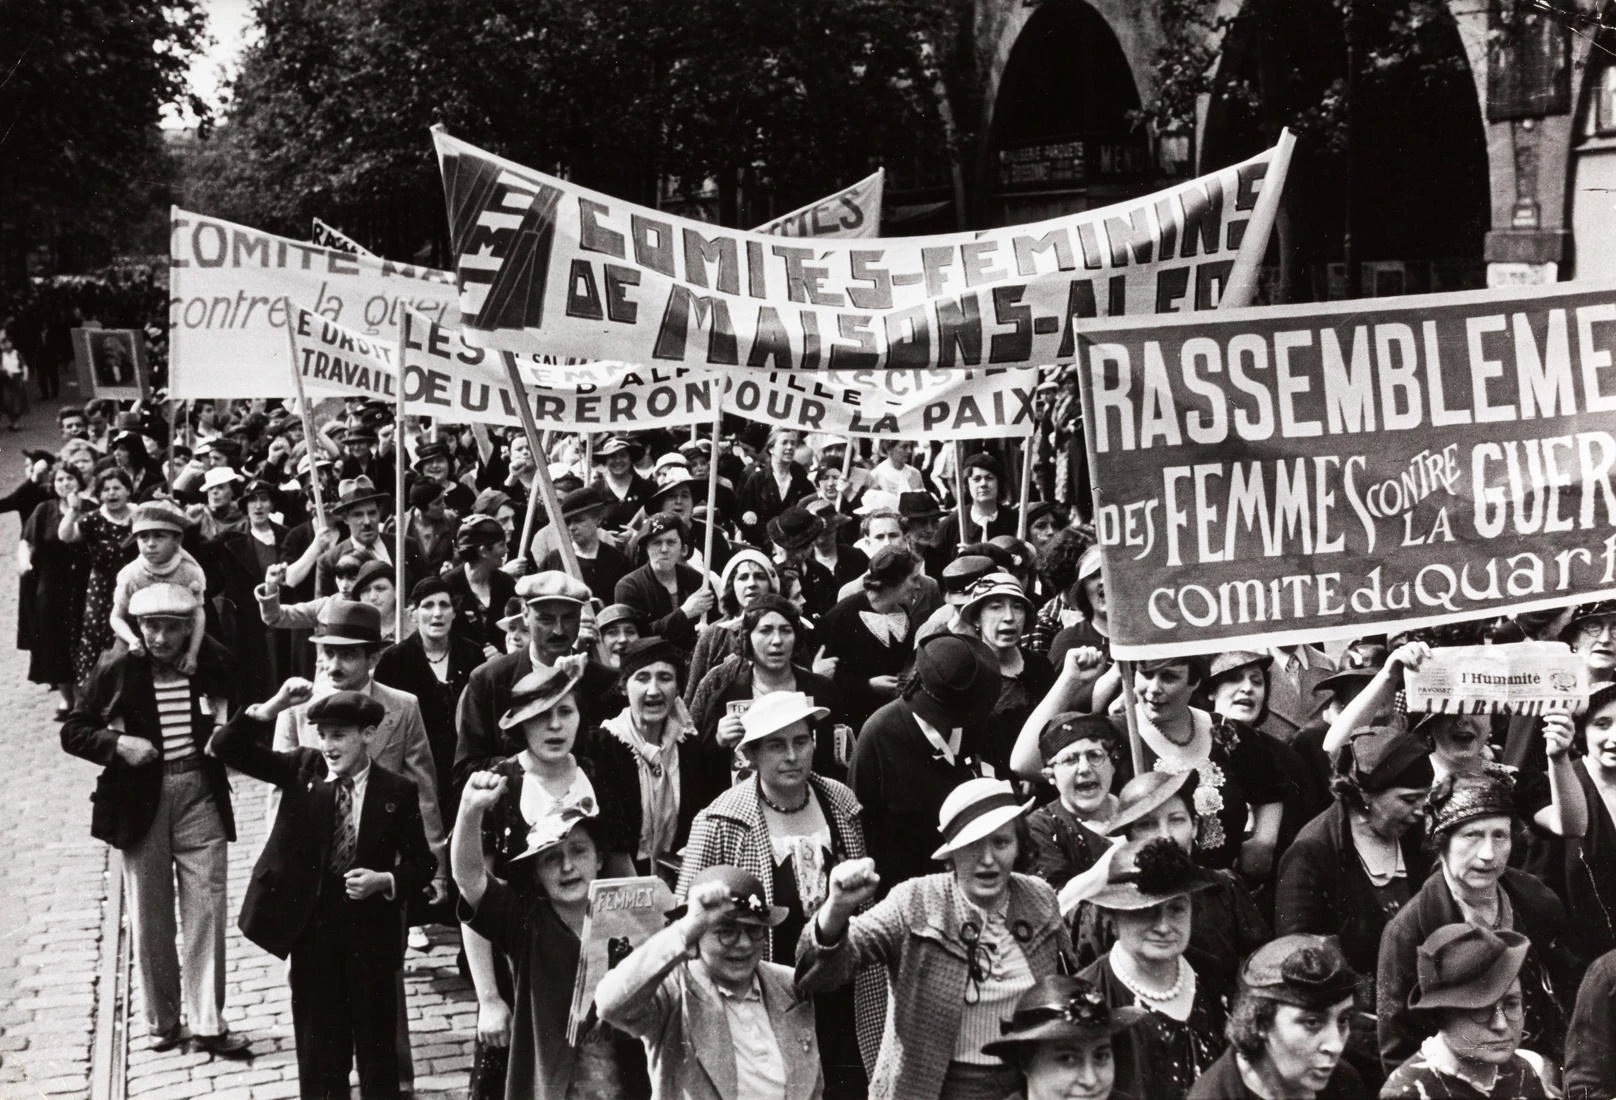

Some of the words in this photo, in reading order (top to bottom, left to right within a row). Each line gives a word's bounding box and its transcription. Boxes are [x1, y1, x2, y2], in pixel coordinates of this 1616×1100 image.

[566, 259, 641, 324] DE
[405, 313, 486, 366] LES
[302, 347, 397, 398] TRAVAIL
[1088, 303, 1616, 453] RASSEMBLEME
[849, 411, 900, 433] LA
[923, 386, 1038, 432] PAIX
[1163, 454, 1377, 567] FEMMES
[1365, 442, 1461, 521] CONTRE
[1471, 430, 1616, 539] GUER
[1099, 498, 1159, 561] DES
[1400, 506, 1456, 548] LA
[599, 886, 655, 912] FEMMES
